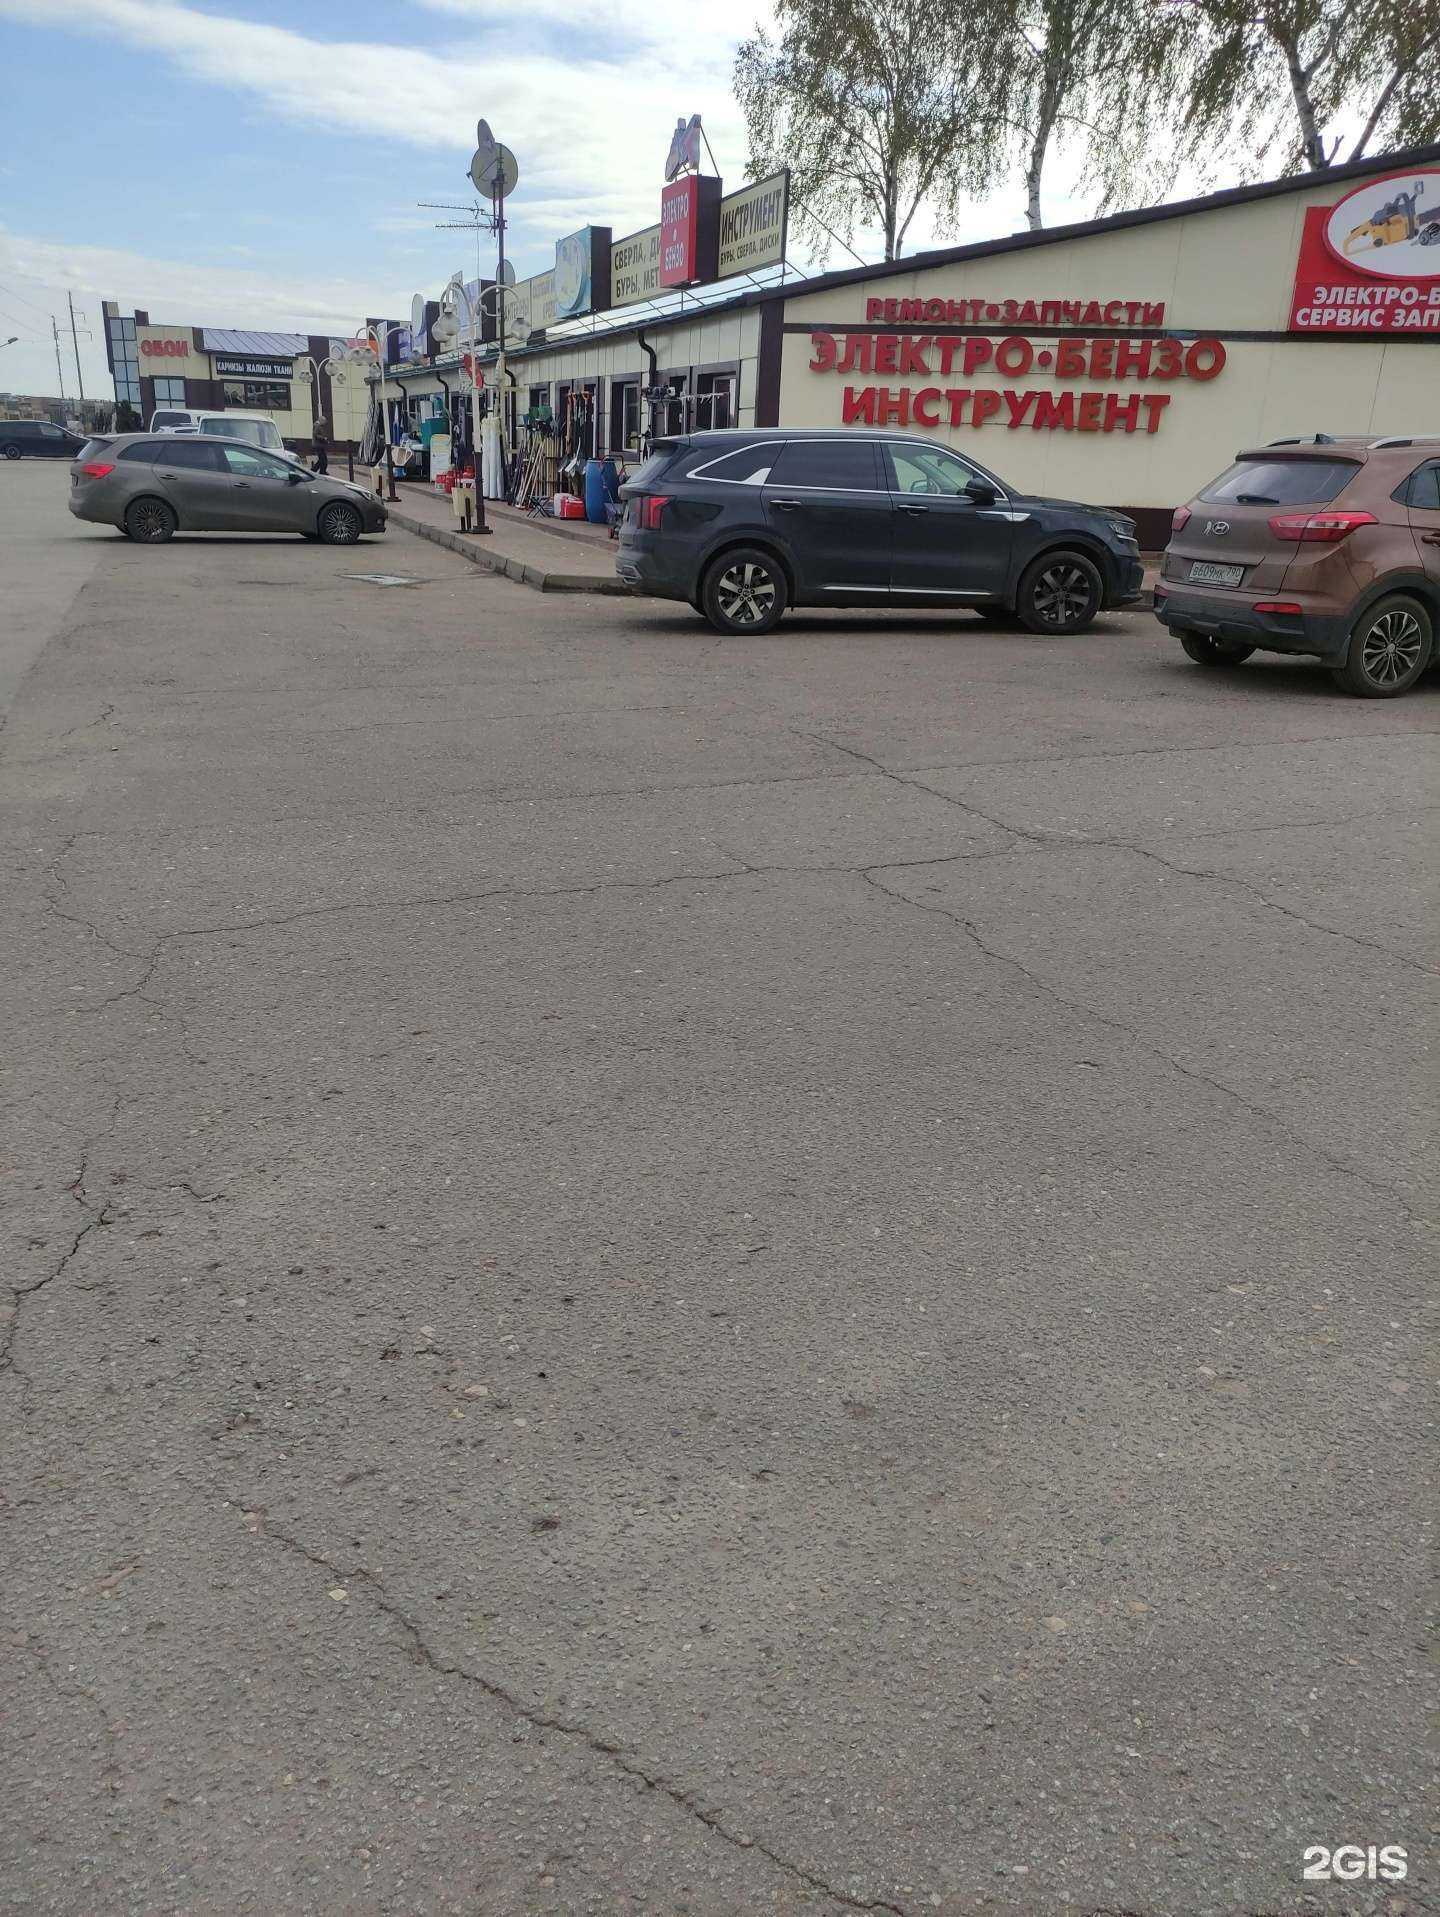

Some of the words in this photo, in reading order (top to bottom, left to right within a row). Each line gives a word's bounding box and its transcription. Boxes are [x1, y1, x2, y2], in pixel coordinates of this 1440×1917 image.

[663, 192, 689, 228] ЭЛЕКТРО
[721, 188, 782, 247] ИНСТРУМЕНТ
[665, 241, 686, 272] БЕНЗО
[1296, 307, 1386, 327] СЕРВИС
[141, 339, 189, 358] ОБОИ
[273, 365, 293, 376] ТКАНИ
[842, 386, 1171, 434] ИНСТРУМЕНТ
